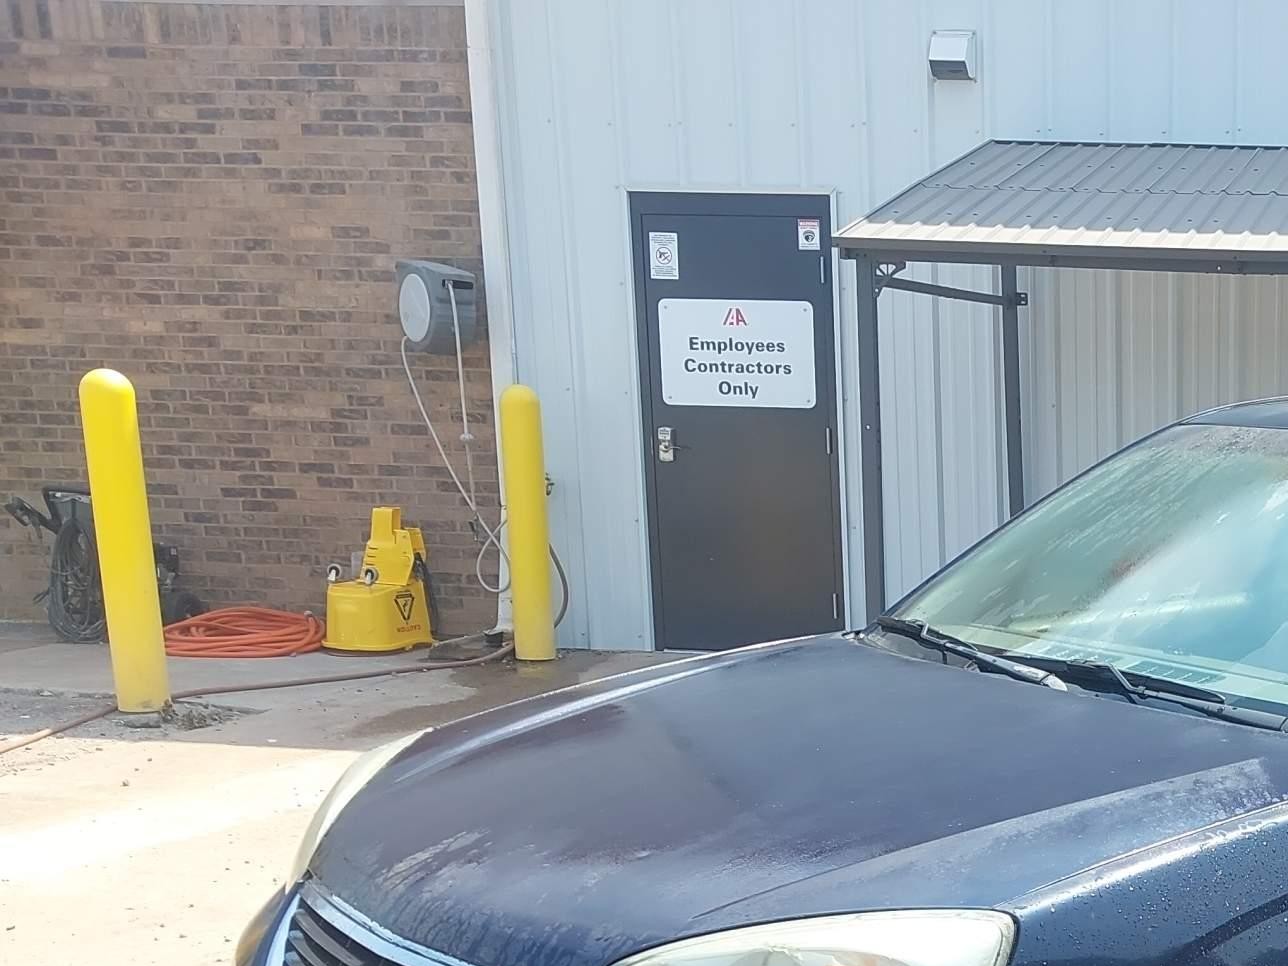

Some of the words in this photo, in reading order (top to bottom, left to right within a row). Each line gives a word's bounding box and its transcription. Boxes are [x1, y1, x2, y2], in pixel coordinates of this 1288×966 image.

[688, 336, 786, 355] Employees
[684, 358, 792, 375] Contractors
[718, 381, 759, 399] Only
